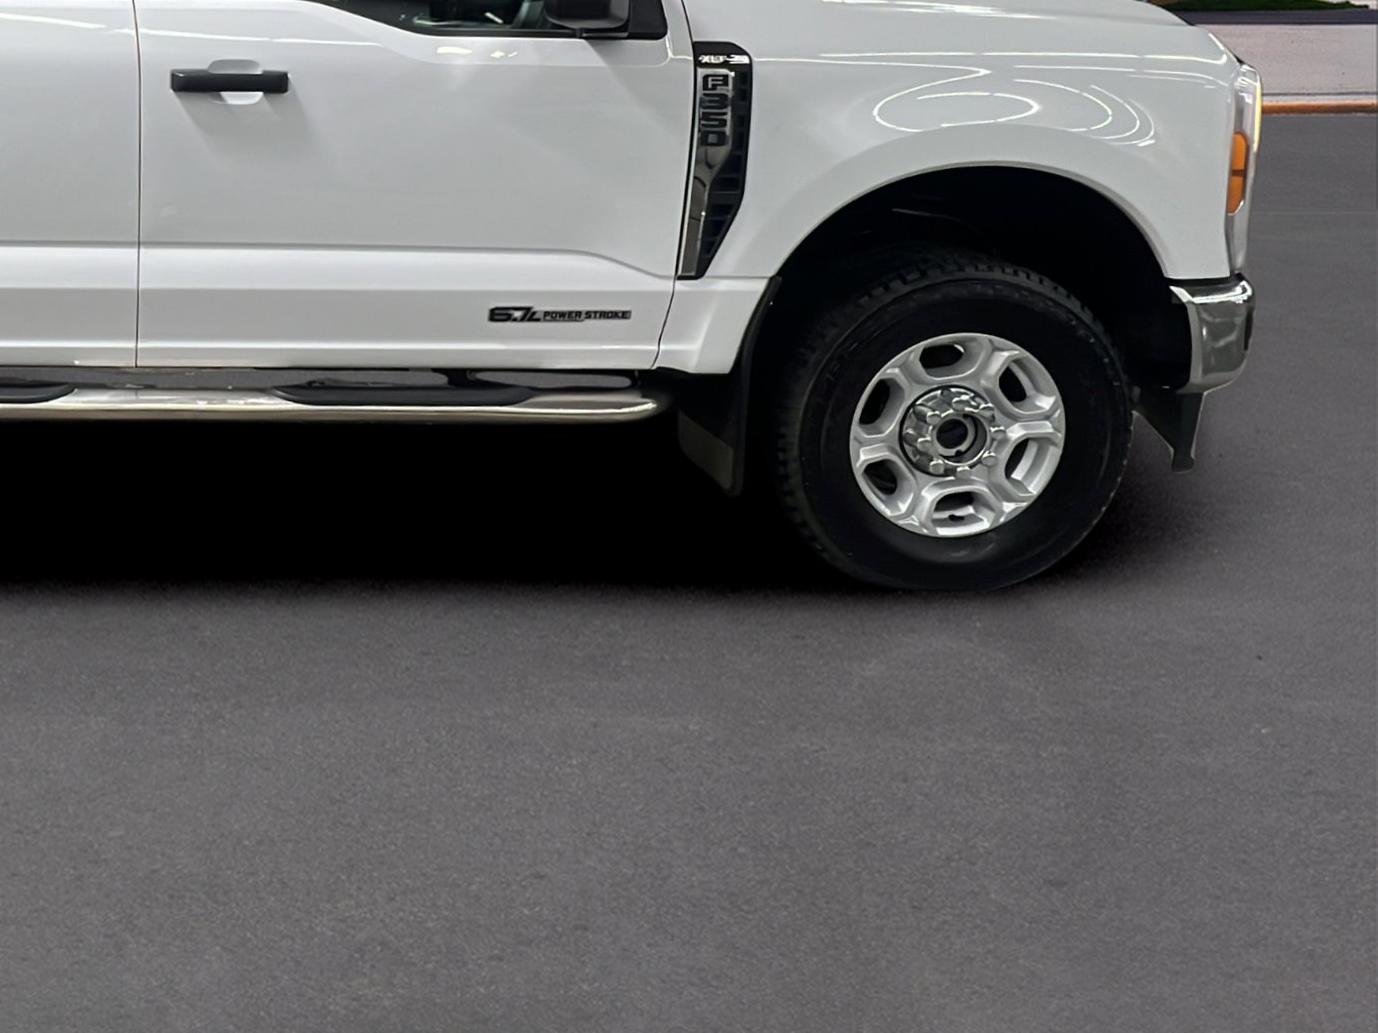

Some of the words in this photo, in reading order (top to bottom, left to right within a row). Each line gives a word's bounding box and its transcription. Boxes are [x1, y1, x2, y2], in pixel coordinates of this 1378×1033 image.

[488, 306, 541, 322] 6.7L
[543, 310, 583, 320] POWER
[584, 310, 632, 320] STROKE
